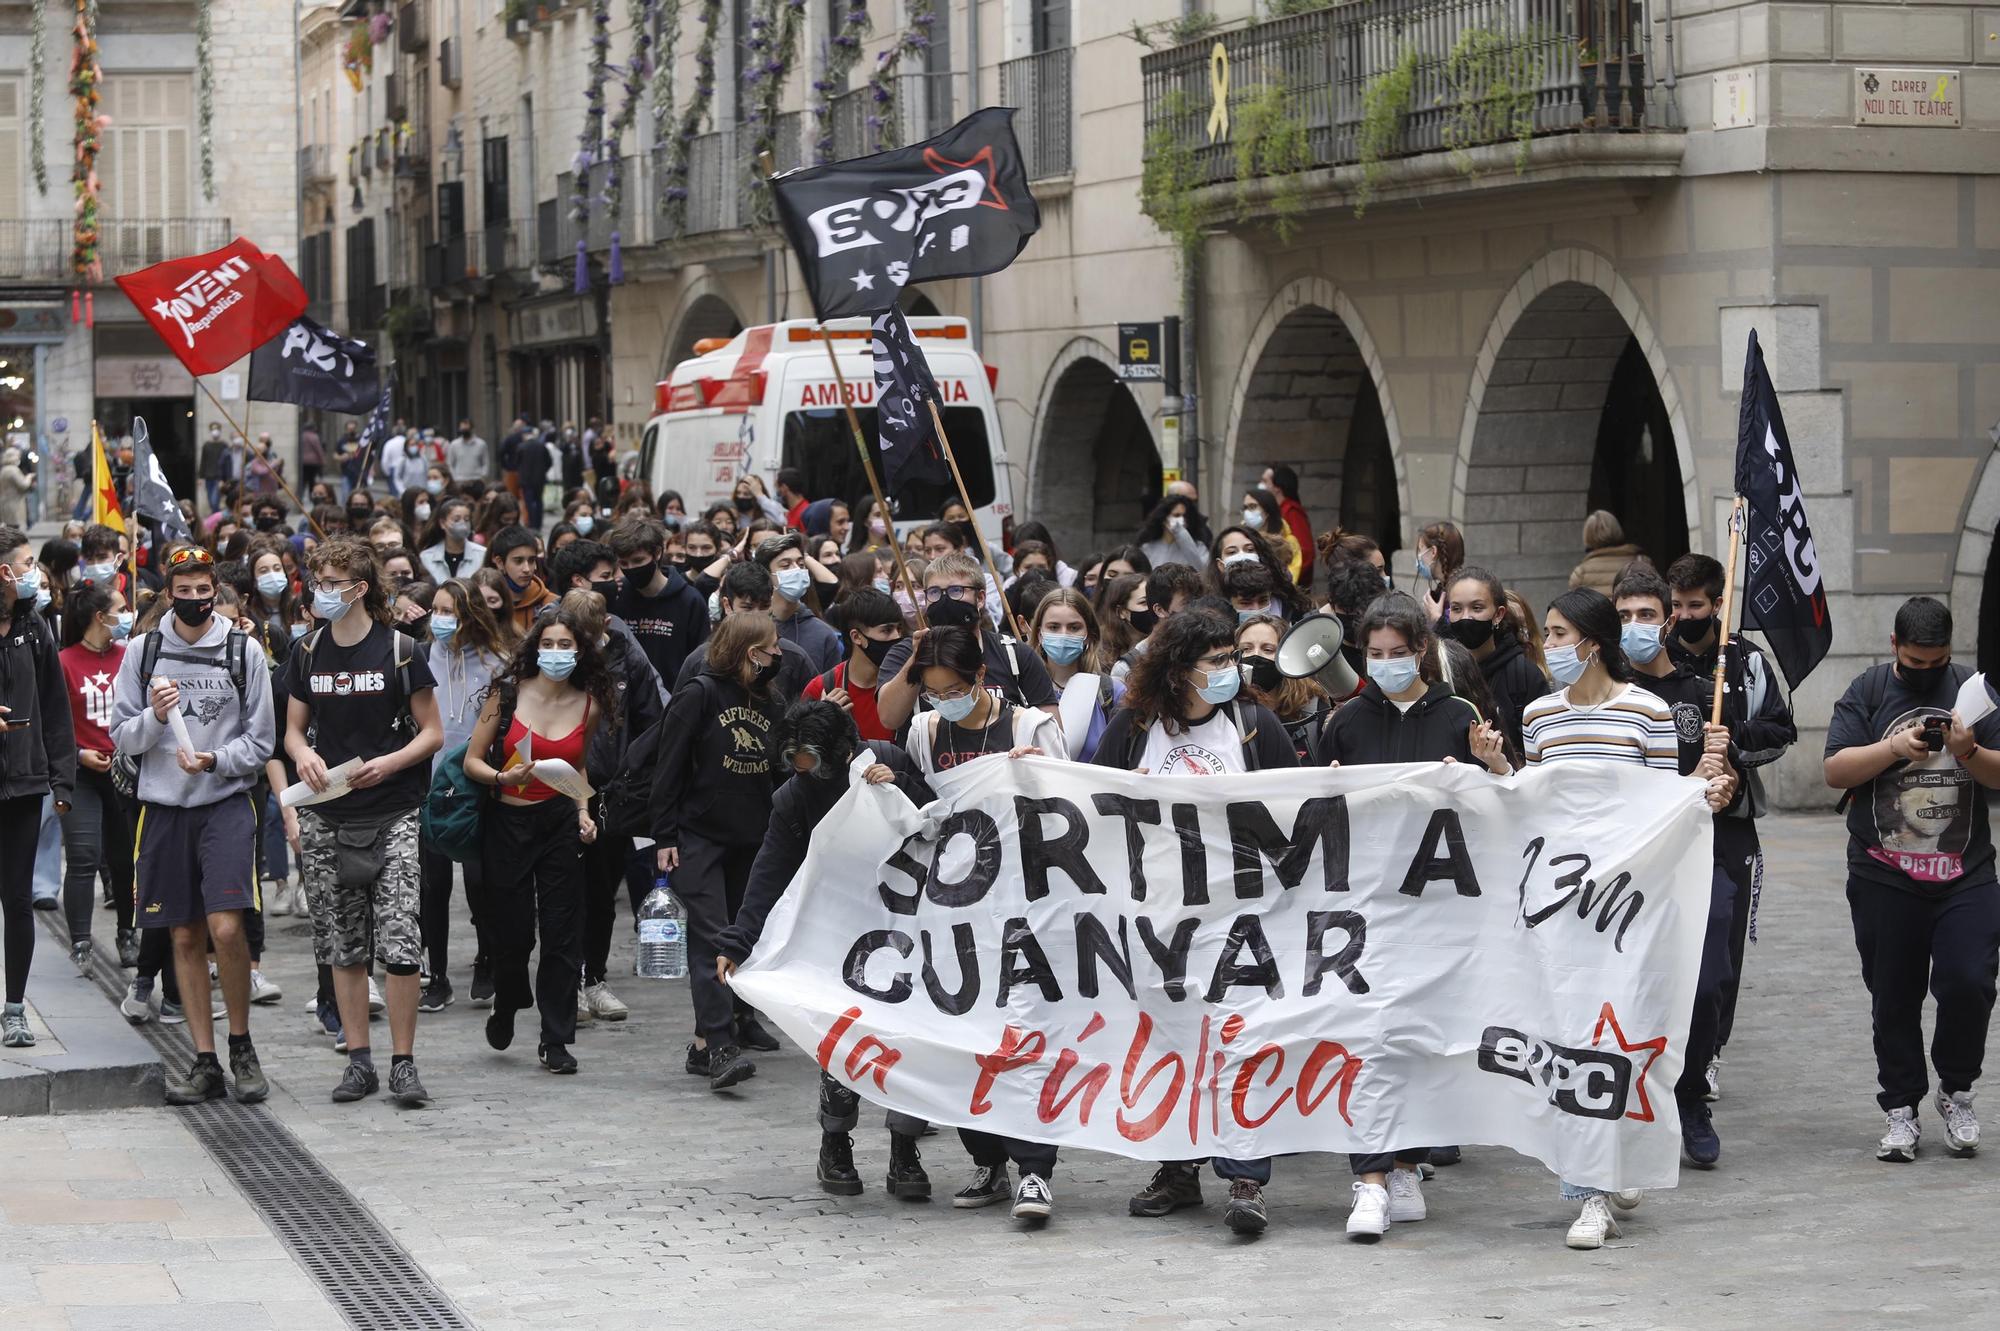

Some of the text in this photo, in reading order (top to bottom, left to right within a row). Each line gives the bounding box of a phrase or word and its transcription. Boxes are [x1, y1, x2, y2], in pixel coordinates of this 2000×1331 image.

[1892, 80, 1927, 93] CARRER
[1864, 99, 1954, 116] NOU DEL TEATRE
[187, 290, 244, 334] Republicà
[801, 379, 968, 407] AMBUIA
[722, 755, 770, 774] WELCOME
[1198, 749, 1224, 772] BAND
[1920, 775, 1941, 784] Save
[877, 793, 1483, 916] SORTIM A
[842, 910, 1371, 1017] GUANYAR
[816, 1005, 902, 1096] la
